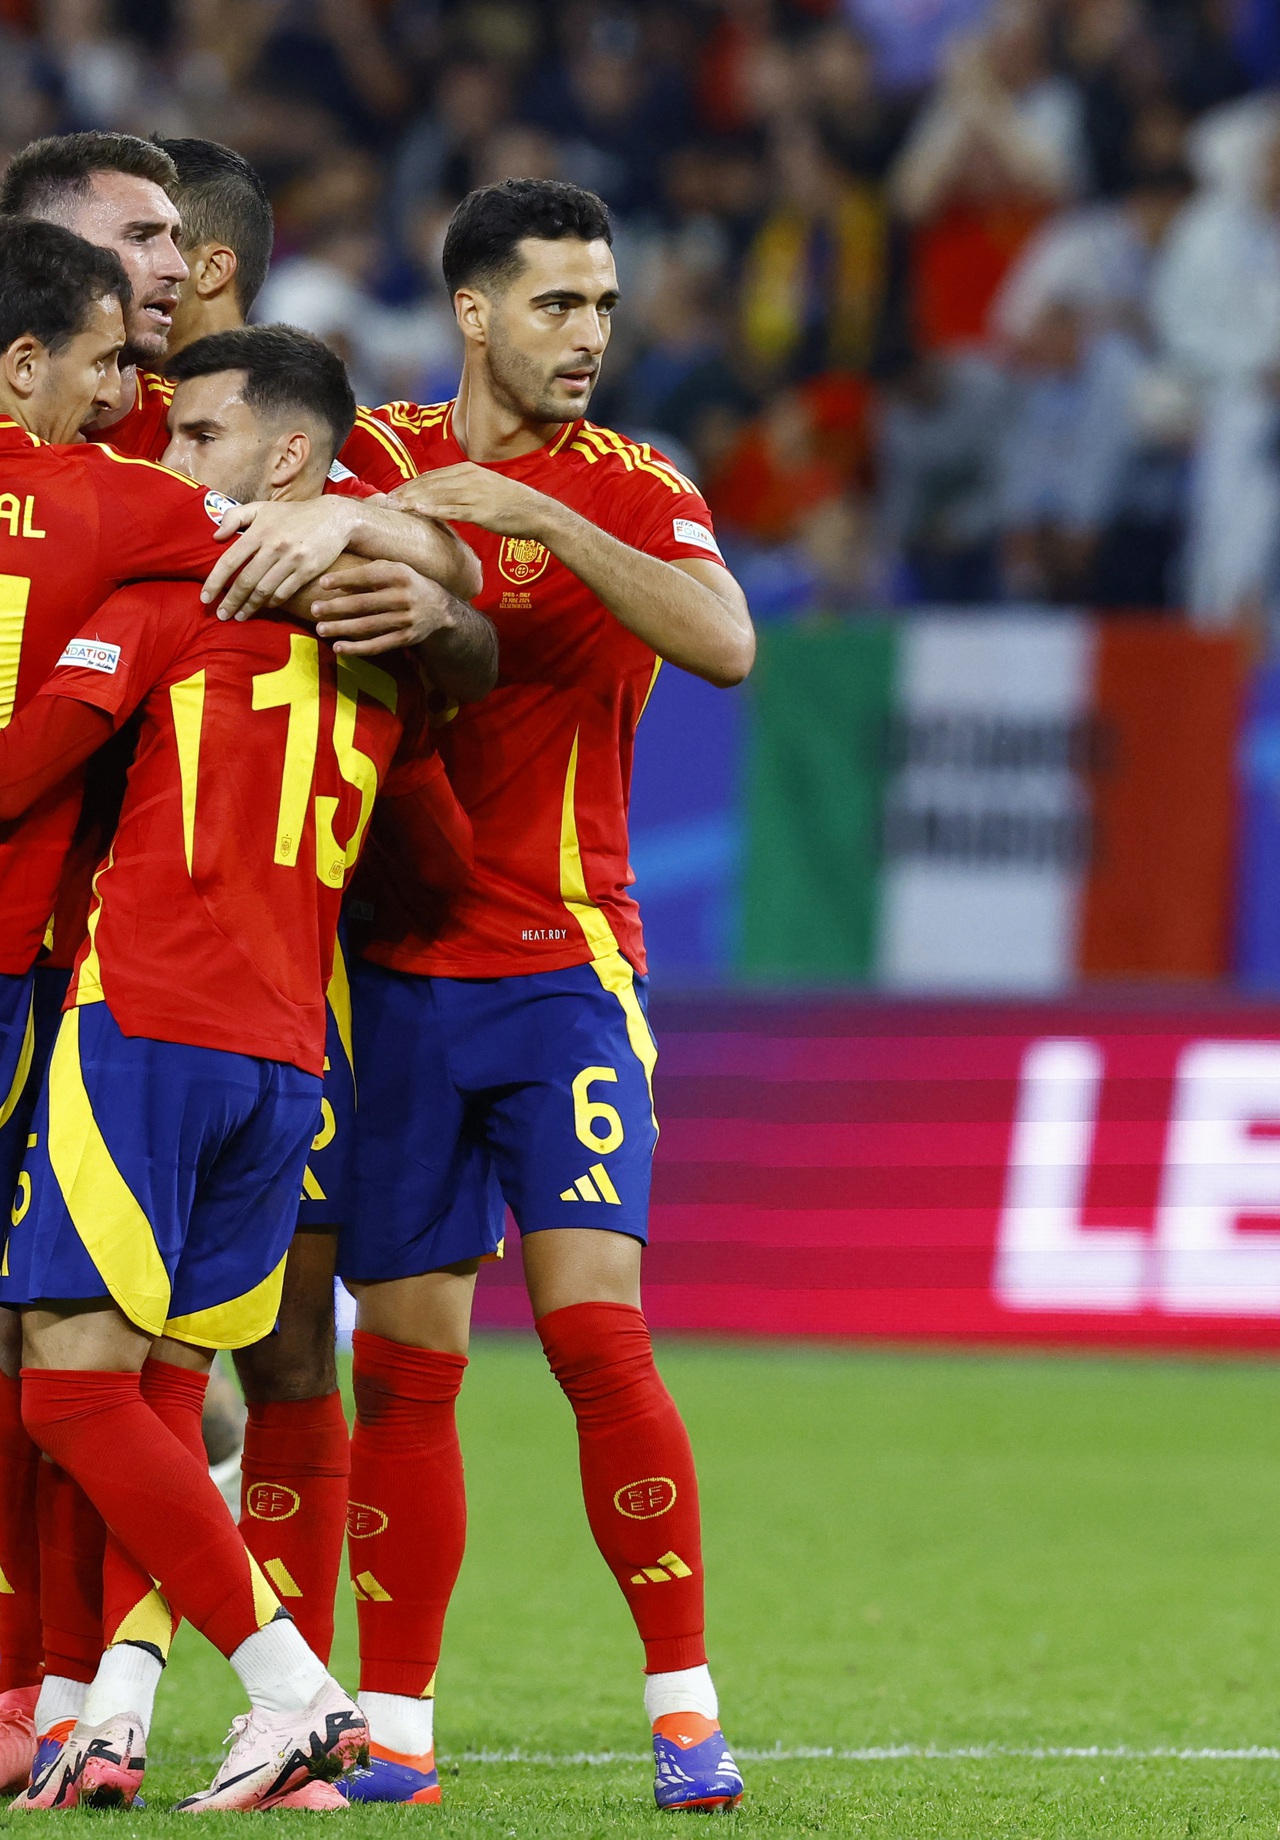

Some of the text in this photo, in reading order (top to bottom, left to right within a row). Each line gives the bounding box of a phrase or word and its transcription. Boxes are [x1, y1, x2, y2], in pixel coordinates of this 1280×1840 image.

[251, 633, 398, 889] 15
[522, 929, 567, 941] HEAT.RDY
[571, 1066, 625, 1155] 6
[993, 1037, 1280, 1316] LE
